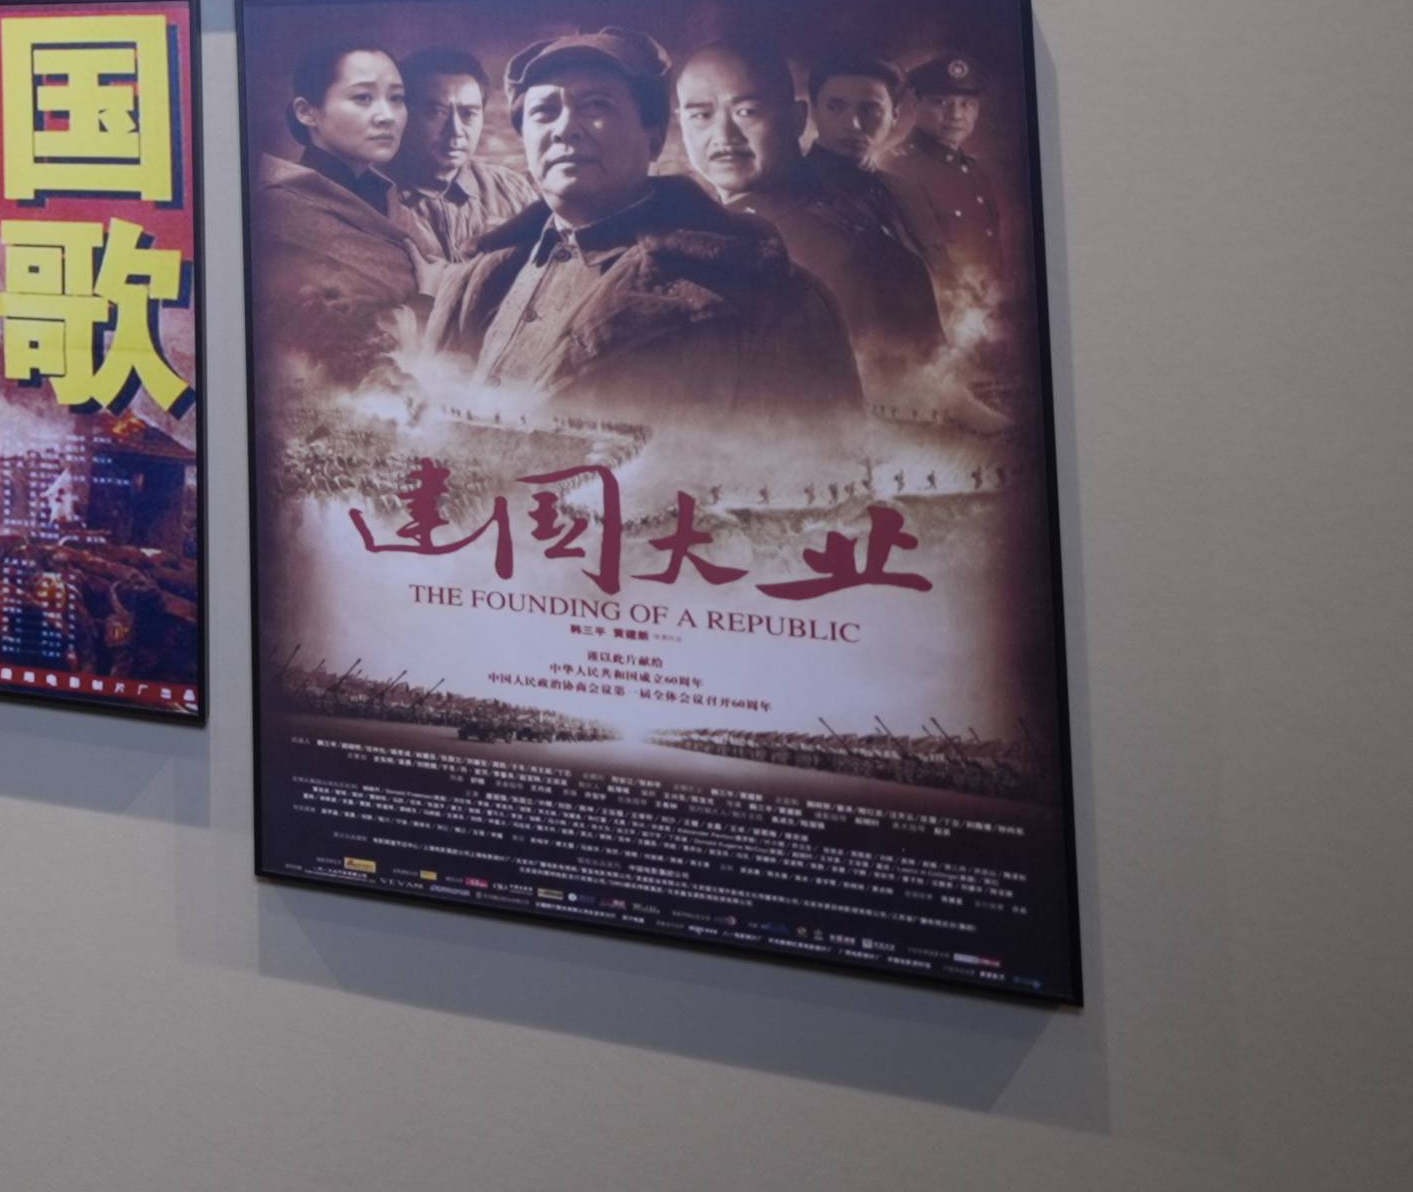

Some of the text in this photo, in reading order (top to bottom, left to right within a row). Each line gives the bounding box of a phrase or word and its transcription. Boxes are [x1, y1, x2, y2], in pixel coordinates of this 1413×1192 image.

[350, 456, 934, 600] 建国大业
[408, 583, 862, 644] THE FOUNDING OF A REPUBLIC
